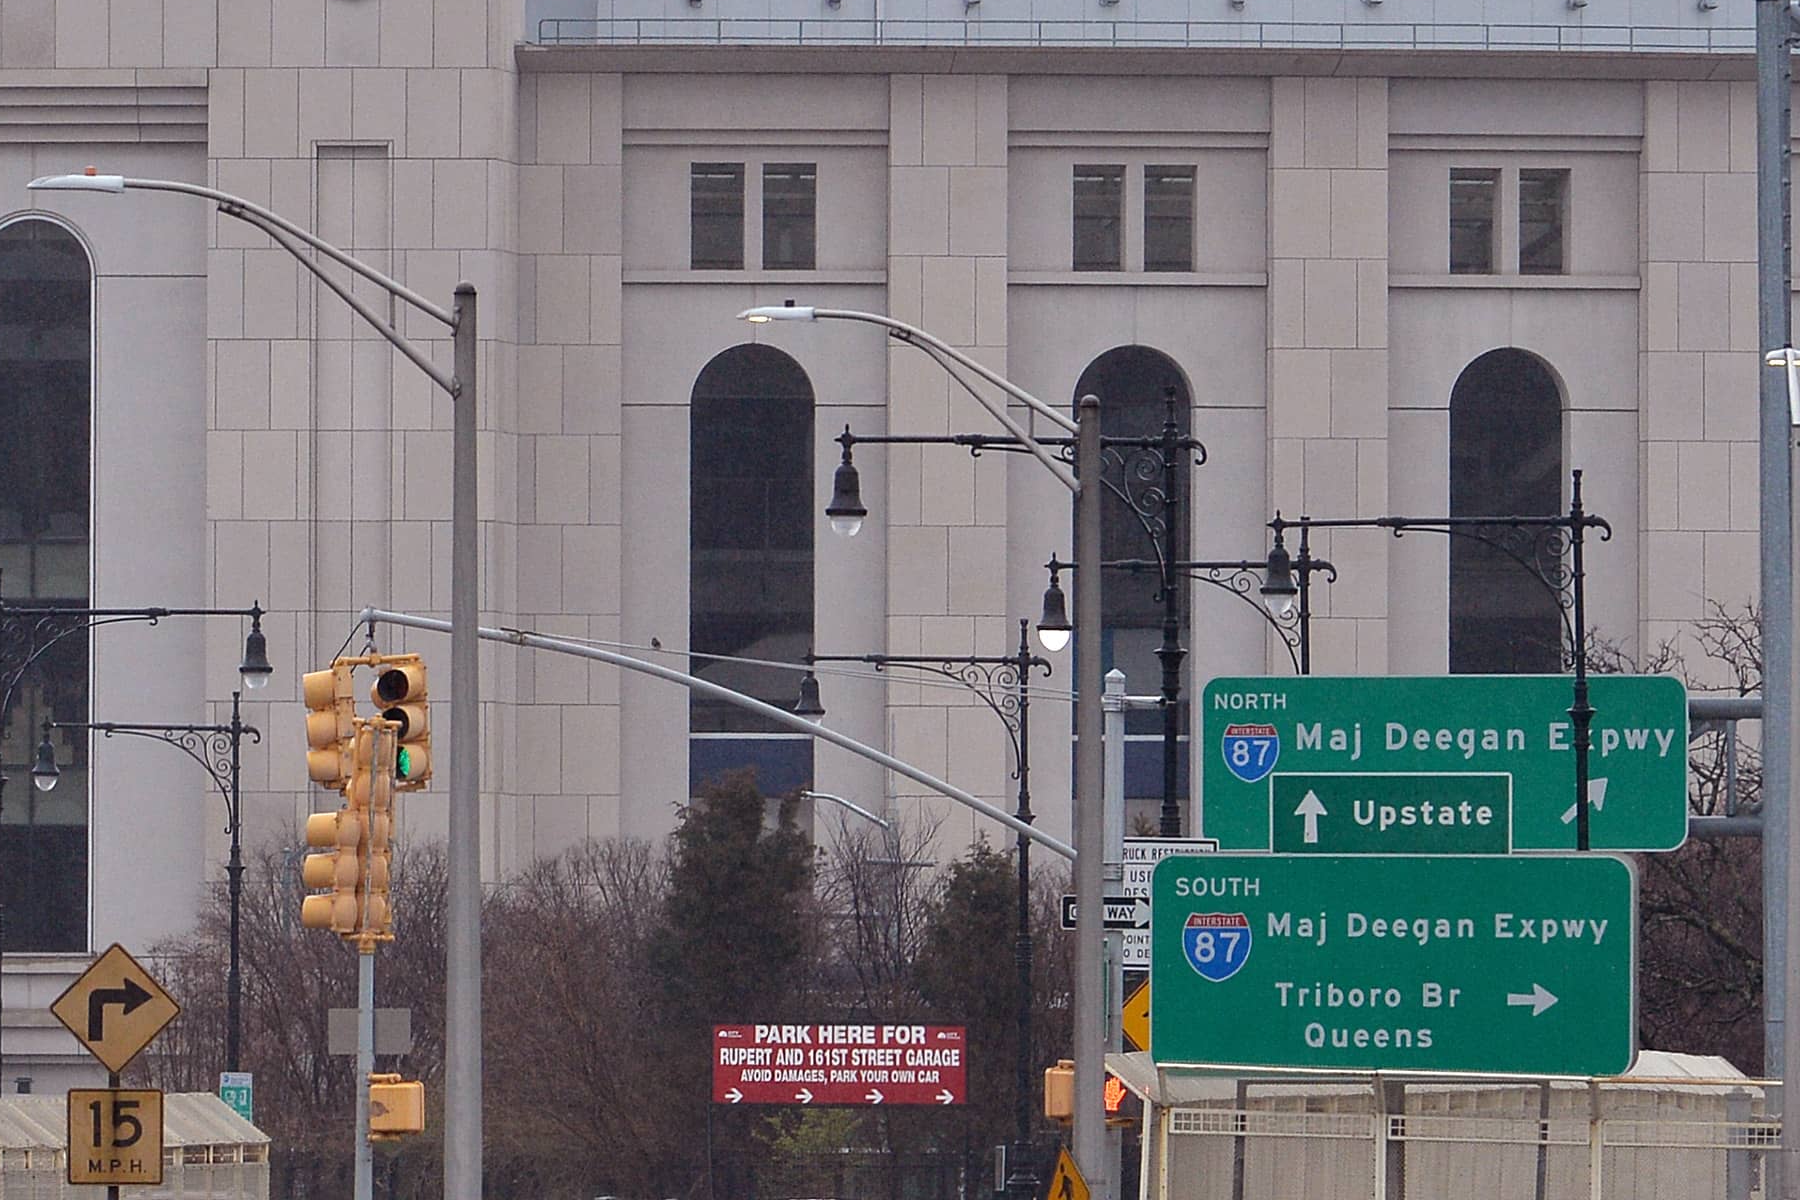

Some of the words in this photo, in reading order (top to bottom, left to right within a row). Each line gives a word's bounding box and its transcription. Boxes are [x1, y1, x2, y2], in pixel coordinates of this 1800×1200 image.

[1214, 693, 1287, 710] NORTH
[1296, 722, 1362, 760] Maj
[1385, 722, 1526, 760] Deegan
[1549, 722, 1675, 758] Epwy
[1232, 740, 1271, 767] 87
[1353, 799, 1494, 831] Upstate
[1122, 848, 1145, 860] RUCK
[1175, 877, 1261, 897] SOUTH
[1107, 906, 1136, 919] WAY
[1193, 916, 1241, 926] INTERSTATE
[1267, 912, 1327, 947] Maj
[1347, 912, 1475, 947] Deegan
[1495, 913, 1609, 945] Expwy
[1126, 934, 1150, 945] OINT
[1194, 931, 1241, 963] 87
[1274, 982, 1402, 1009] Triboro
[1422, 982, 1462, 1009] Br
[754, 1025, 812, 1044] PARK
[818, 1025, 876, 1044] HERE
[882, 1025, 926, 1044] FOR
[1304, 1023, 1433, 1049] Queens
[720, 1048, 773, 1065] RUPERT
[776, 1048, 804, 1065] AND
[808, 1049, 848, 1066] 161ST
[851, 1049, 902, 1066] STREET
[905, 1049, 960, 1066] GARAGE
[740, 1069, 772, 1082] AVOID
[774, 1069, 828, 1086] DAMAGES,
[830, 1070, 858, 1082] PARK
[860, 1070, 889, 1083] YOUR
[891, 1070, 916, 1083] OWN
[918, 1071, 940, 1083] CAR
[89, 1100, 143, 1148] 15
[88, 1159, 147, 1173] M.P.H.
